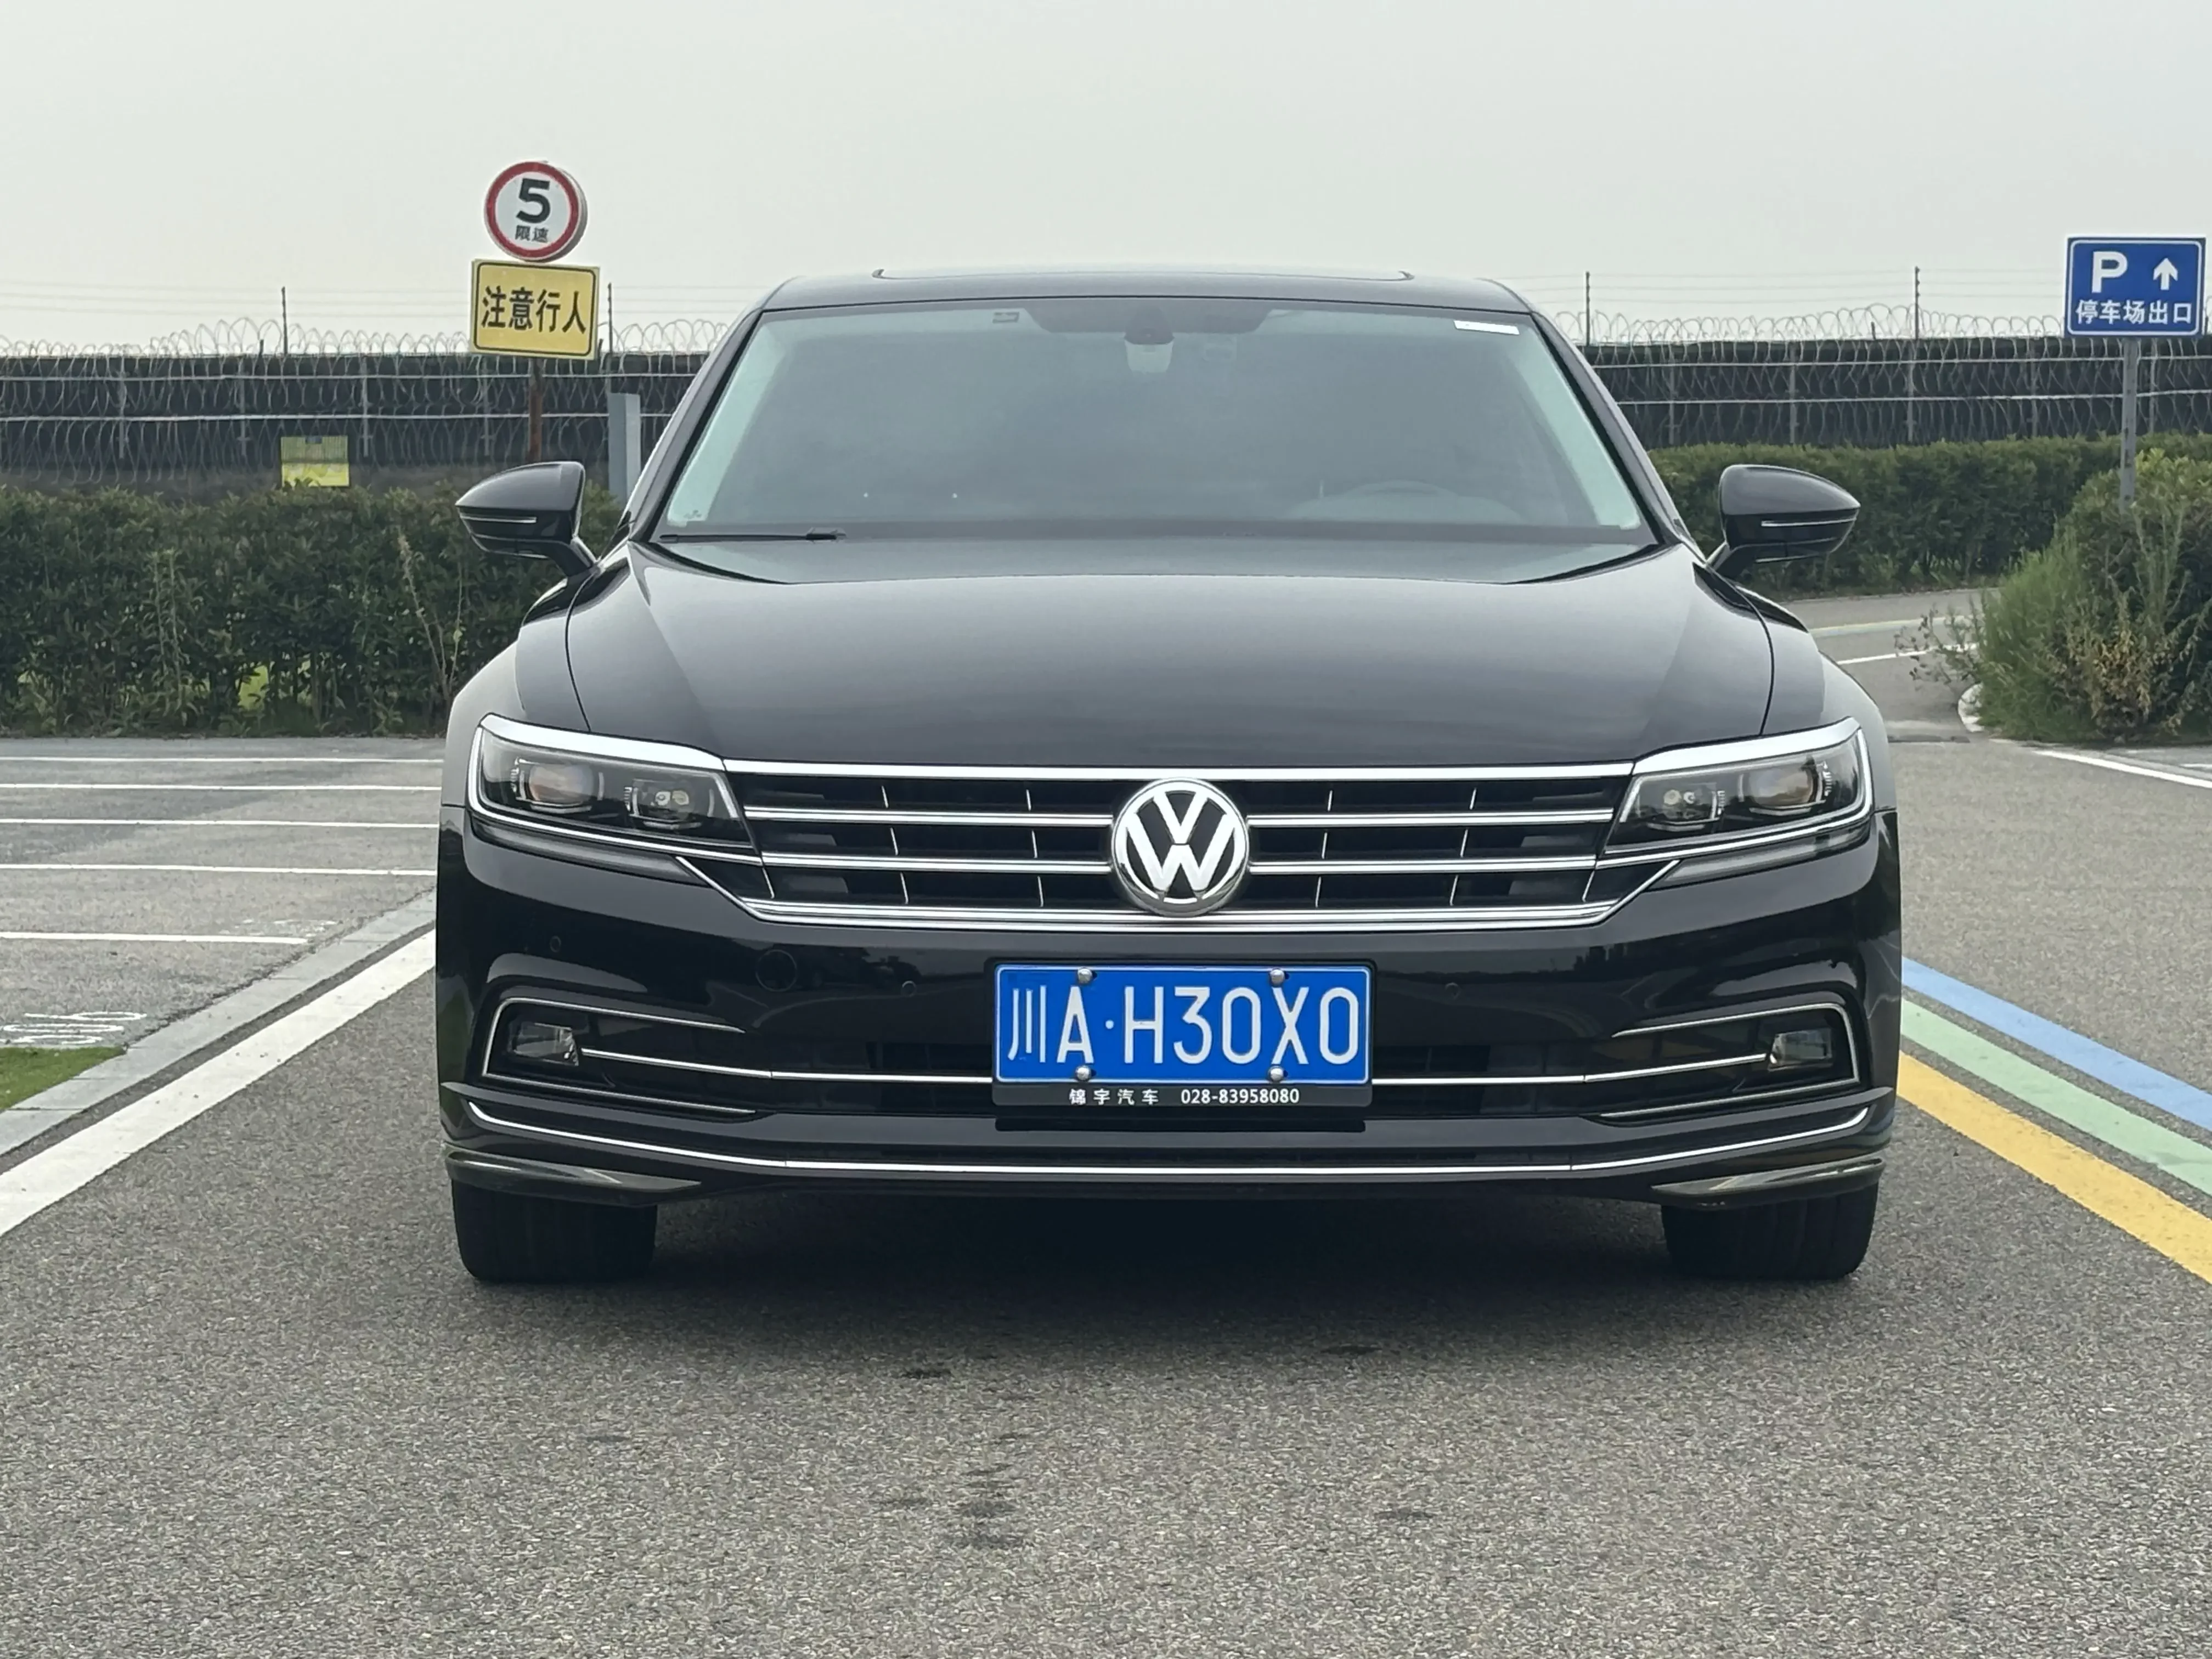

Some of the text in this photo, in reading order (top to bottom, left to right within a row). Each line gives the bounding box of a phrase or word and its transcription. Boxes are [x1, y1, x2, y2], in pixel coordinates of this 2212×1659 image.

[516, 178, 551, 224] 5
[515, 225, 549, 243] 限速
[2091, 251, 2128, 293] P
[481, 285, 586, 334] 注意行人
[2075, 299, 2192, 325] 停车场出口
[1069, 1088, 1300, 1105] 锦宇汽车 028-83958080
